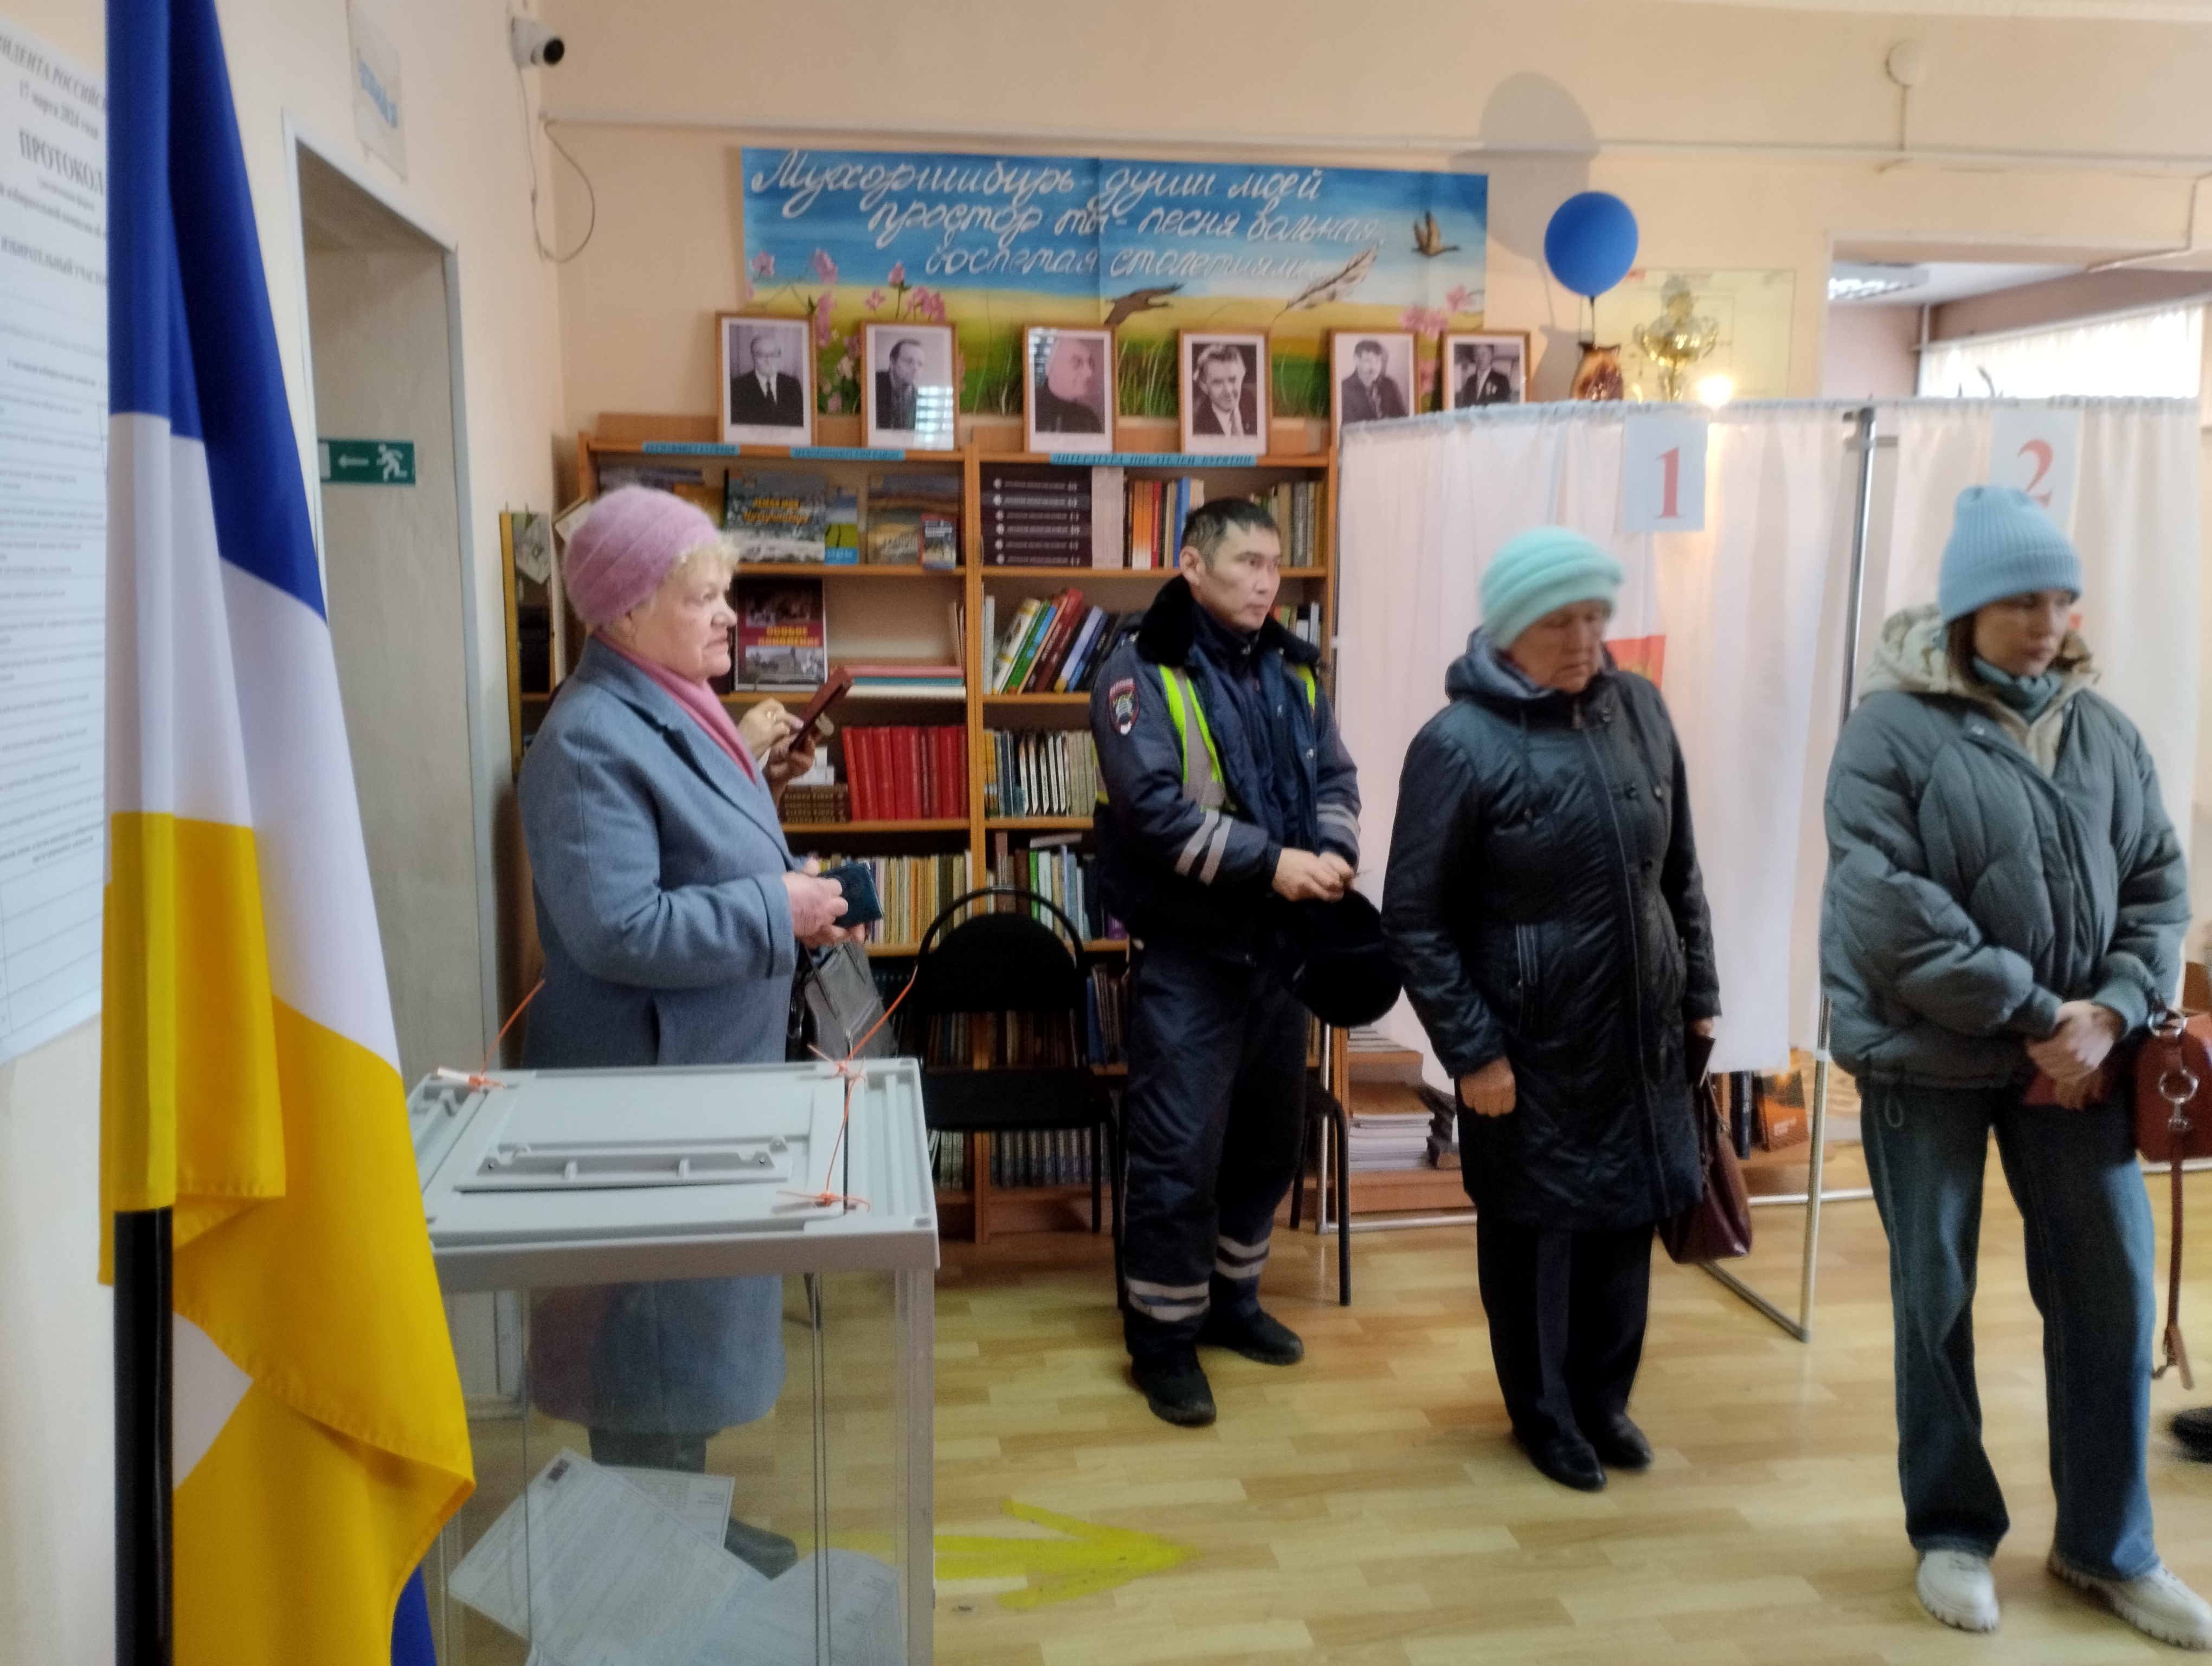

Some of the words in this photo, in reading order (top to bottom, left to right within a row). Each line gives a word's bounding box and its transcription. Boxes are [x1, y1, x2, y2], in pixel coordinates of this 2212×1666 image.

[18, 125, 103, 197] ПРОТОКОЛ
[1086, 167, 1217, 217] души
[1227, 168, 1323, 201] моей
[925, 228, 1098, 275] воспетая
[1137, 207, 1242, 237] песня
[1654, 445, 1687, 519] 1
[2015, 438, 2055, 507] 2
